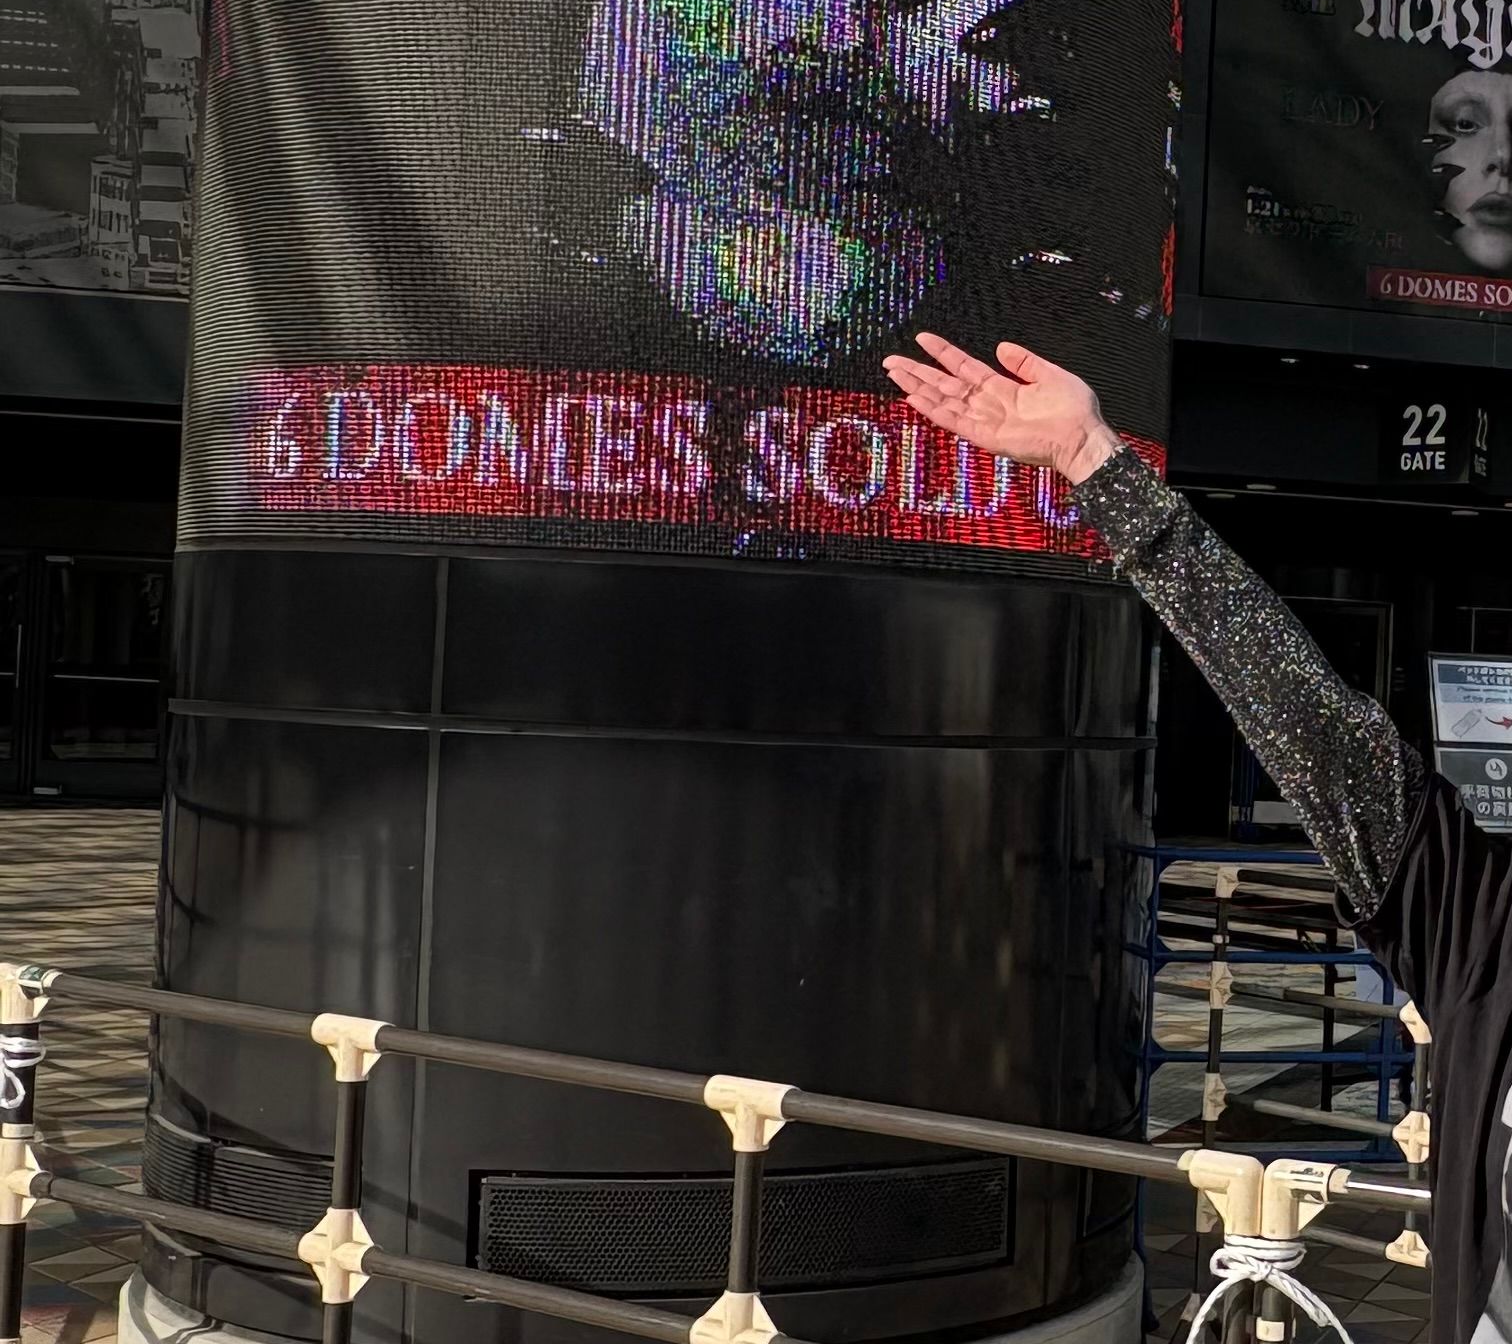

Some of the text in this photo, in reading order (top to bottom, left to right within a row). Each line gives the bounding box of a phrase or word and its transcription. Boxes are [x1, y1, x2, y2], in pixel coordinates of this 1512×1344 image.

[1380, 272, 1392, 294] 6
[1397, 275, 1478, 303] DOMES
[260, 391, 306, 484] 6
[322, 389, 712, 497] DOMES
[1402, 403, 1447, 446] 22
[1400, 451, 1446, 471] GATE
